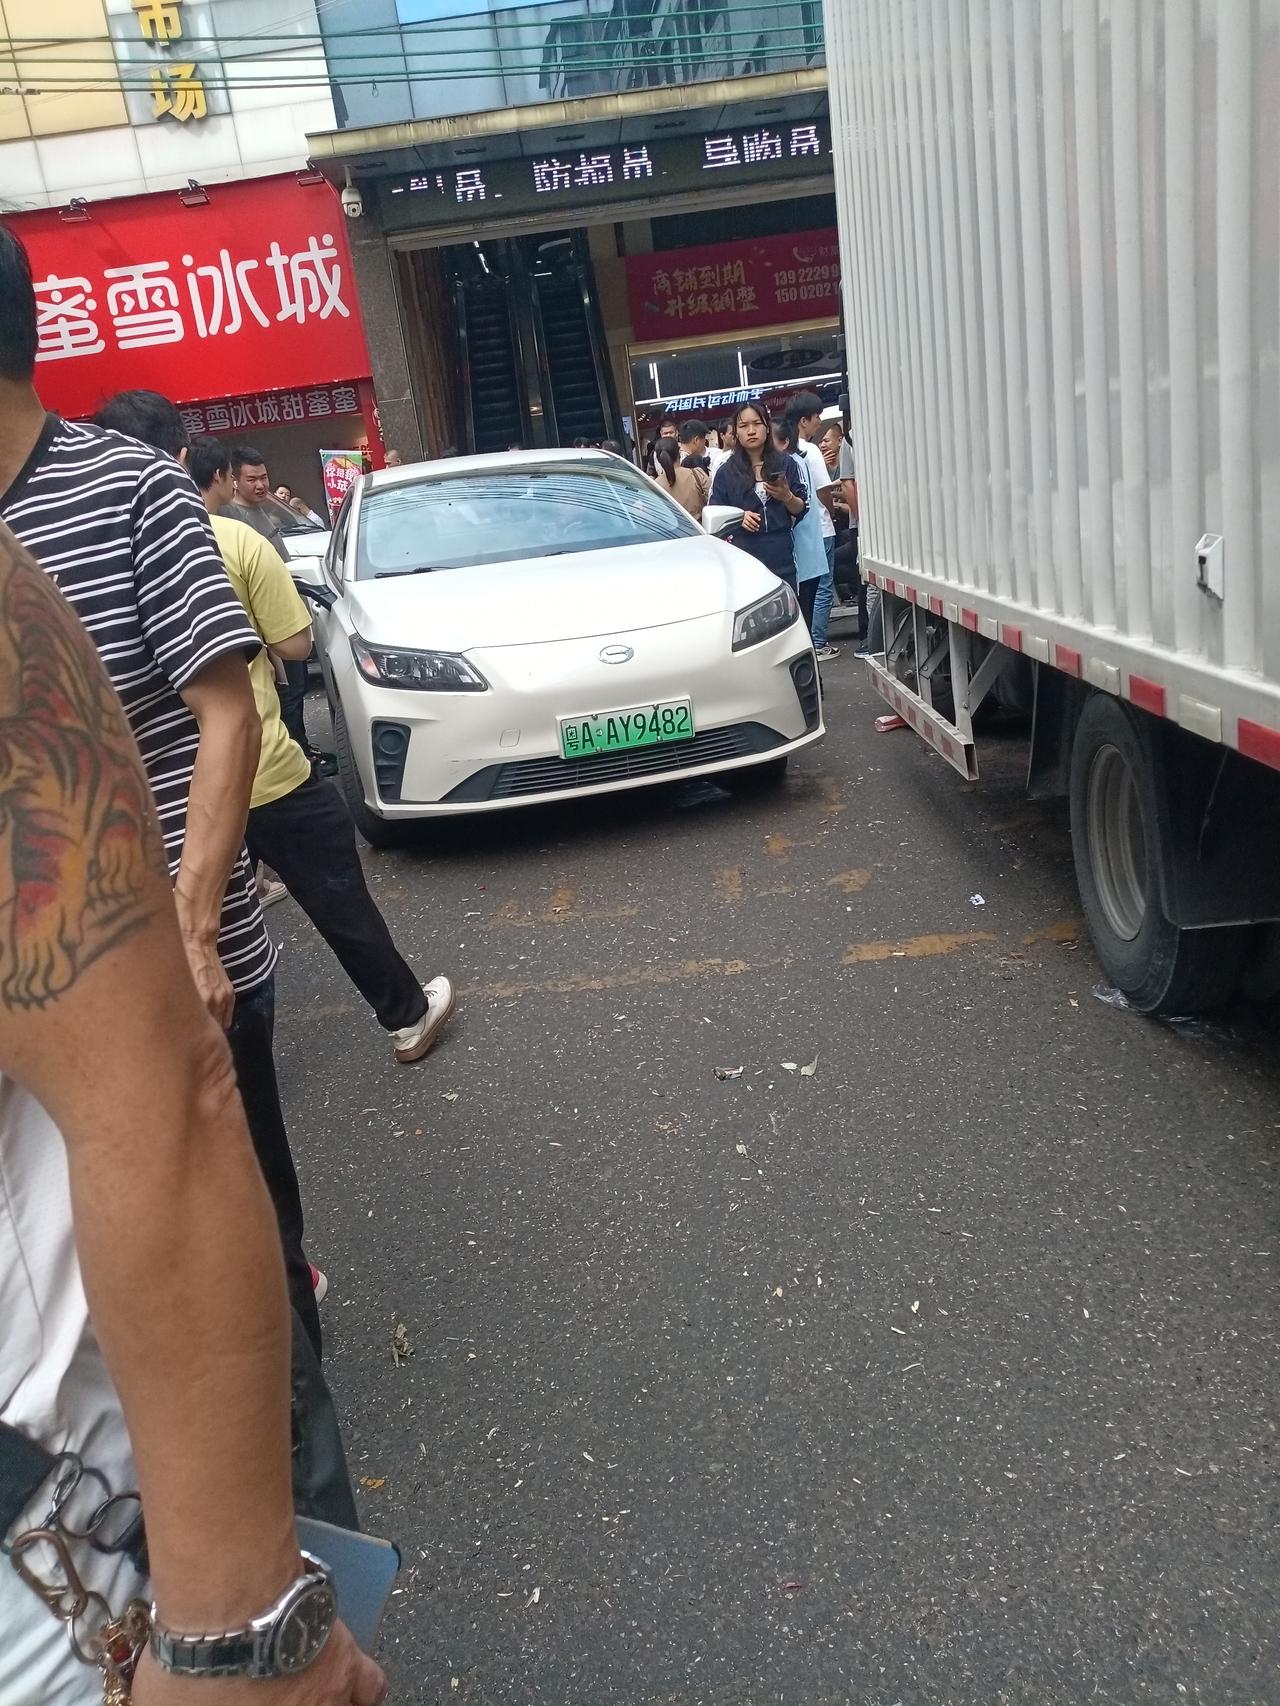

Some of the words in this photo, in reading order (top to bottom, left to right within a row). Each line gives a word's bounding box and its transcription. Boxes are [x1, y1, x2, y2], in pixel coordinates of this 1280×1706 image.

[33, 234, 350, 362] 蜜雪冰城
[651, 259, 746, 296] 商铺到期
[179, 386, 358, 434] 蜜雪冰城甜蜜蜜
